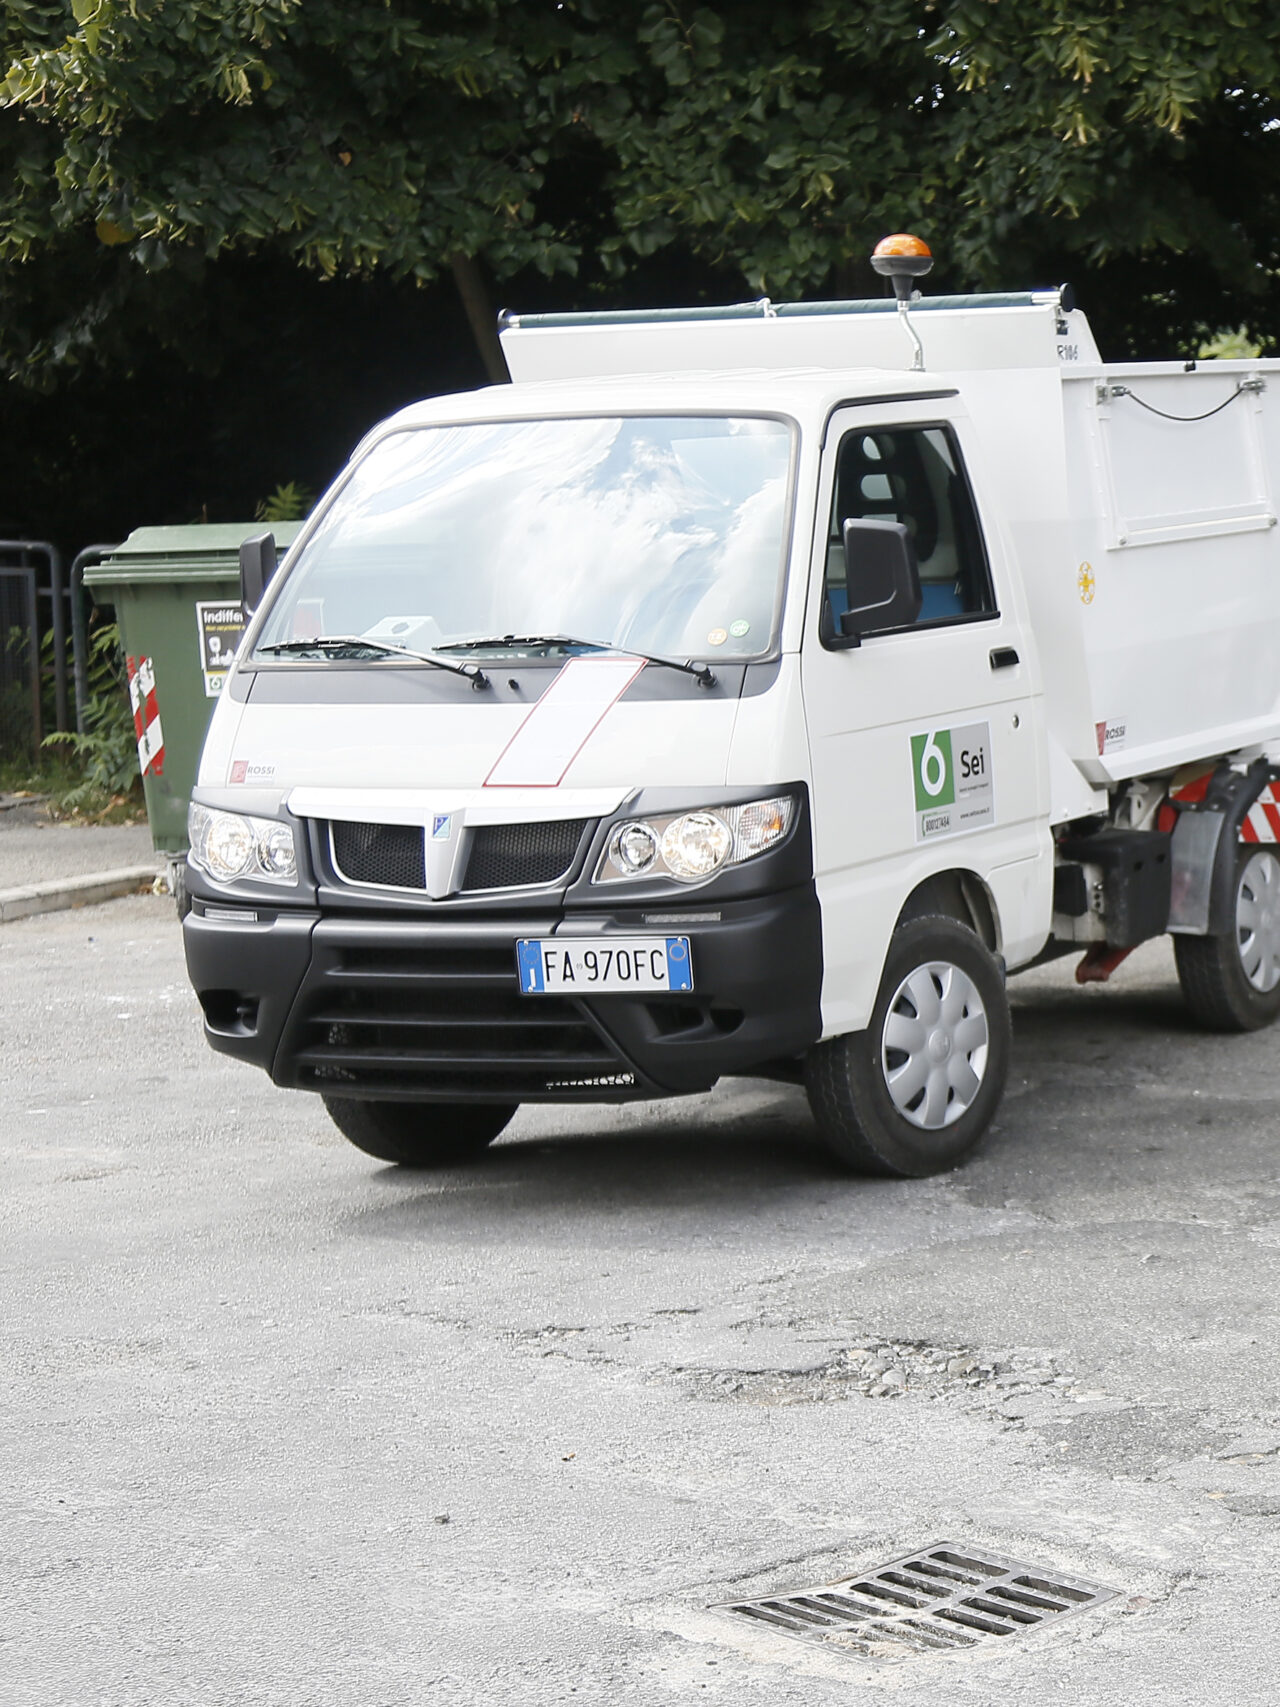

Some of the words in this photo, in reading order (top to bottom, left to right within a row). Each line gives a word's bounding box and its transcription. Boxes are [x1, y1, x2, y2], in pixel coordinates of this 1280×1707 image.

[1105, 726, 1125, 740] ROSSI
[247, 765, 275, 775] ROSSI
[921, 730, 946, 797] 6
[960, 747, 985, 779] Sei
